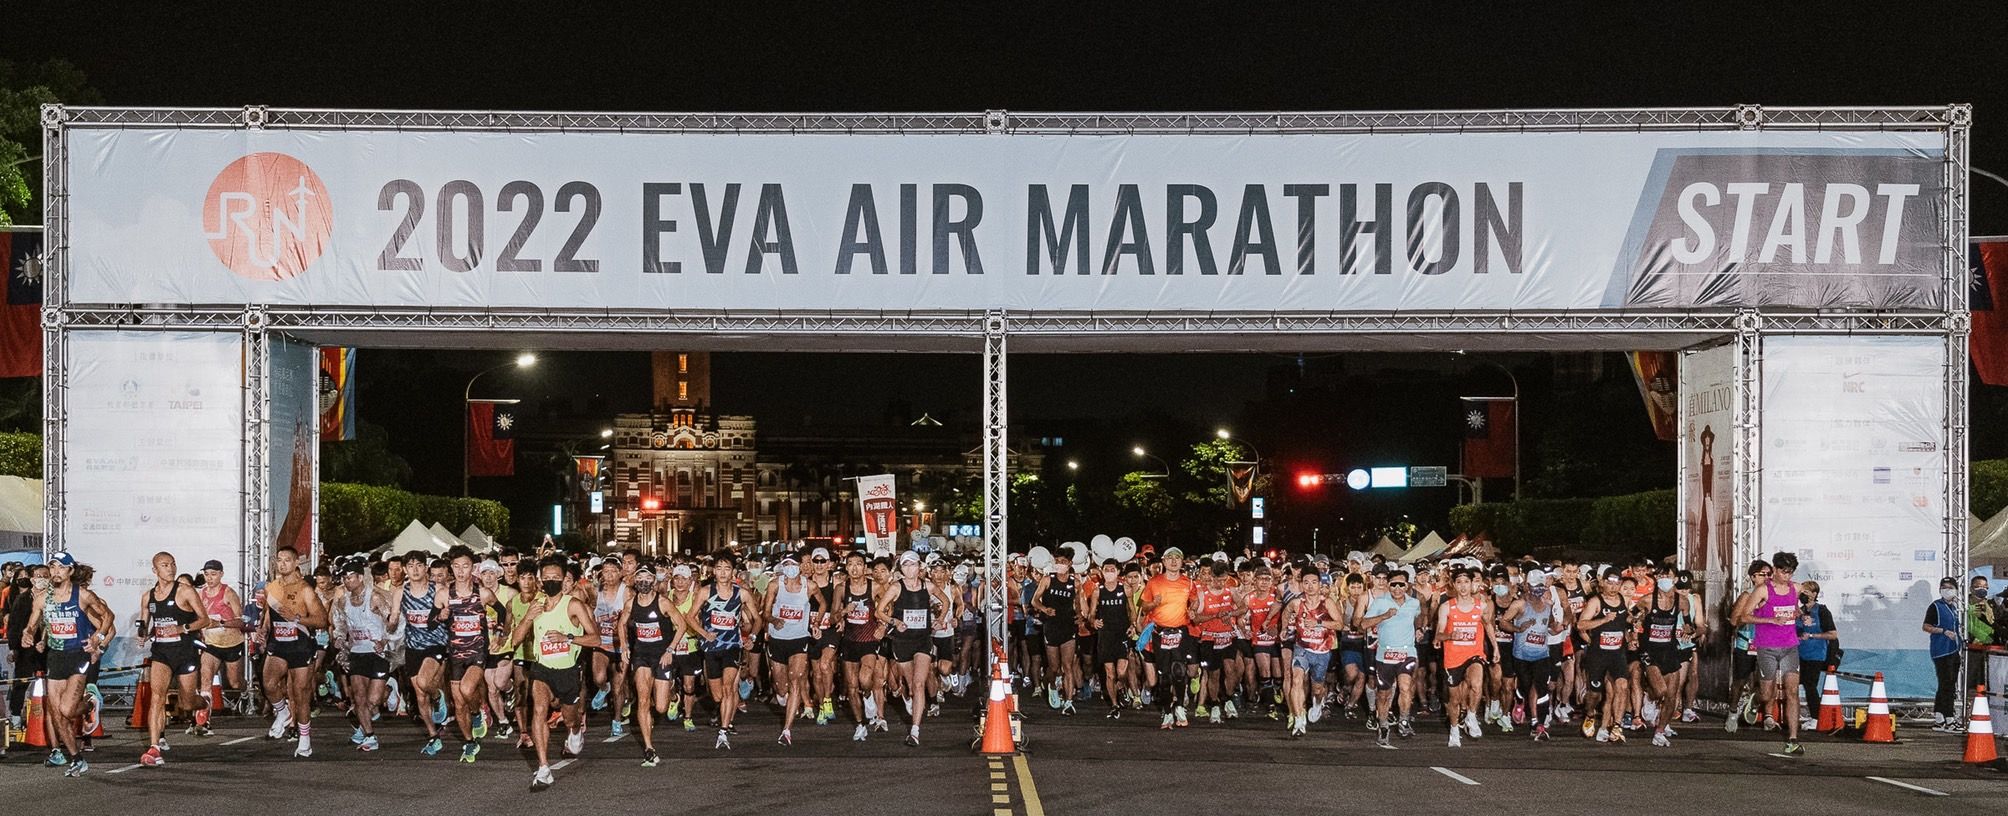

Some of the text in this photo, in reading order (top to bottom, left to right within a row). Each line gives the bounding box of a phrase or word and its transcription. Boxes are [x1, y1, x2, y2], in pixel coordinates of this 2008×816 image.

[204, 176, 316, 268] RUN
[377, 179, 1524, 276] 2022 EVA AIR MARATHON
[1671, 181, 1920, 266] START
[1842, 381, 1865, 393] NRC
[168, 400, 203, 410] TAIPEI
[1826, 551, 1856, 563] meiji
[1049, 588, 1072, 599] PACER
[1100, 598, 1123, 607] PACER
[542, 642, 569, 652] 04413
